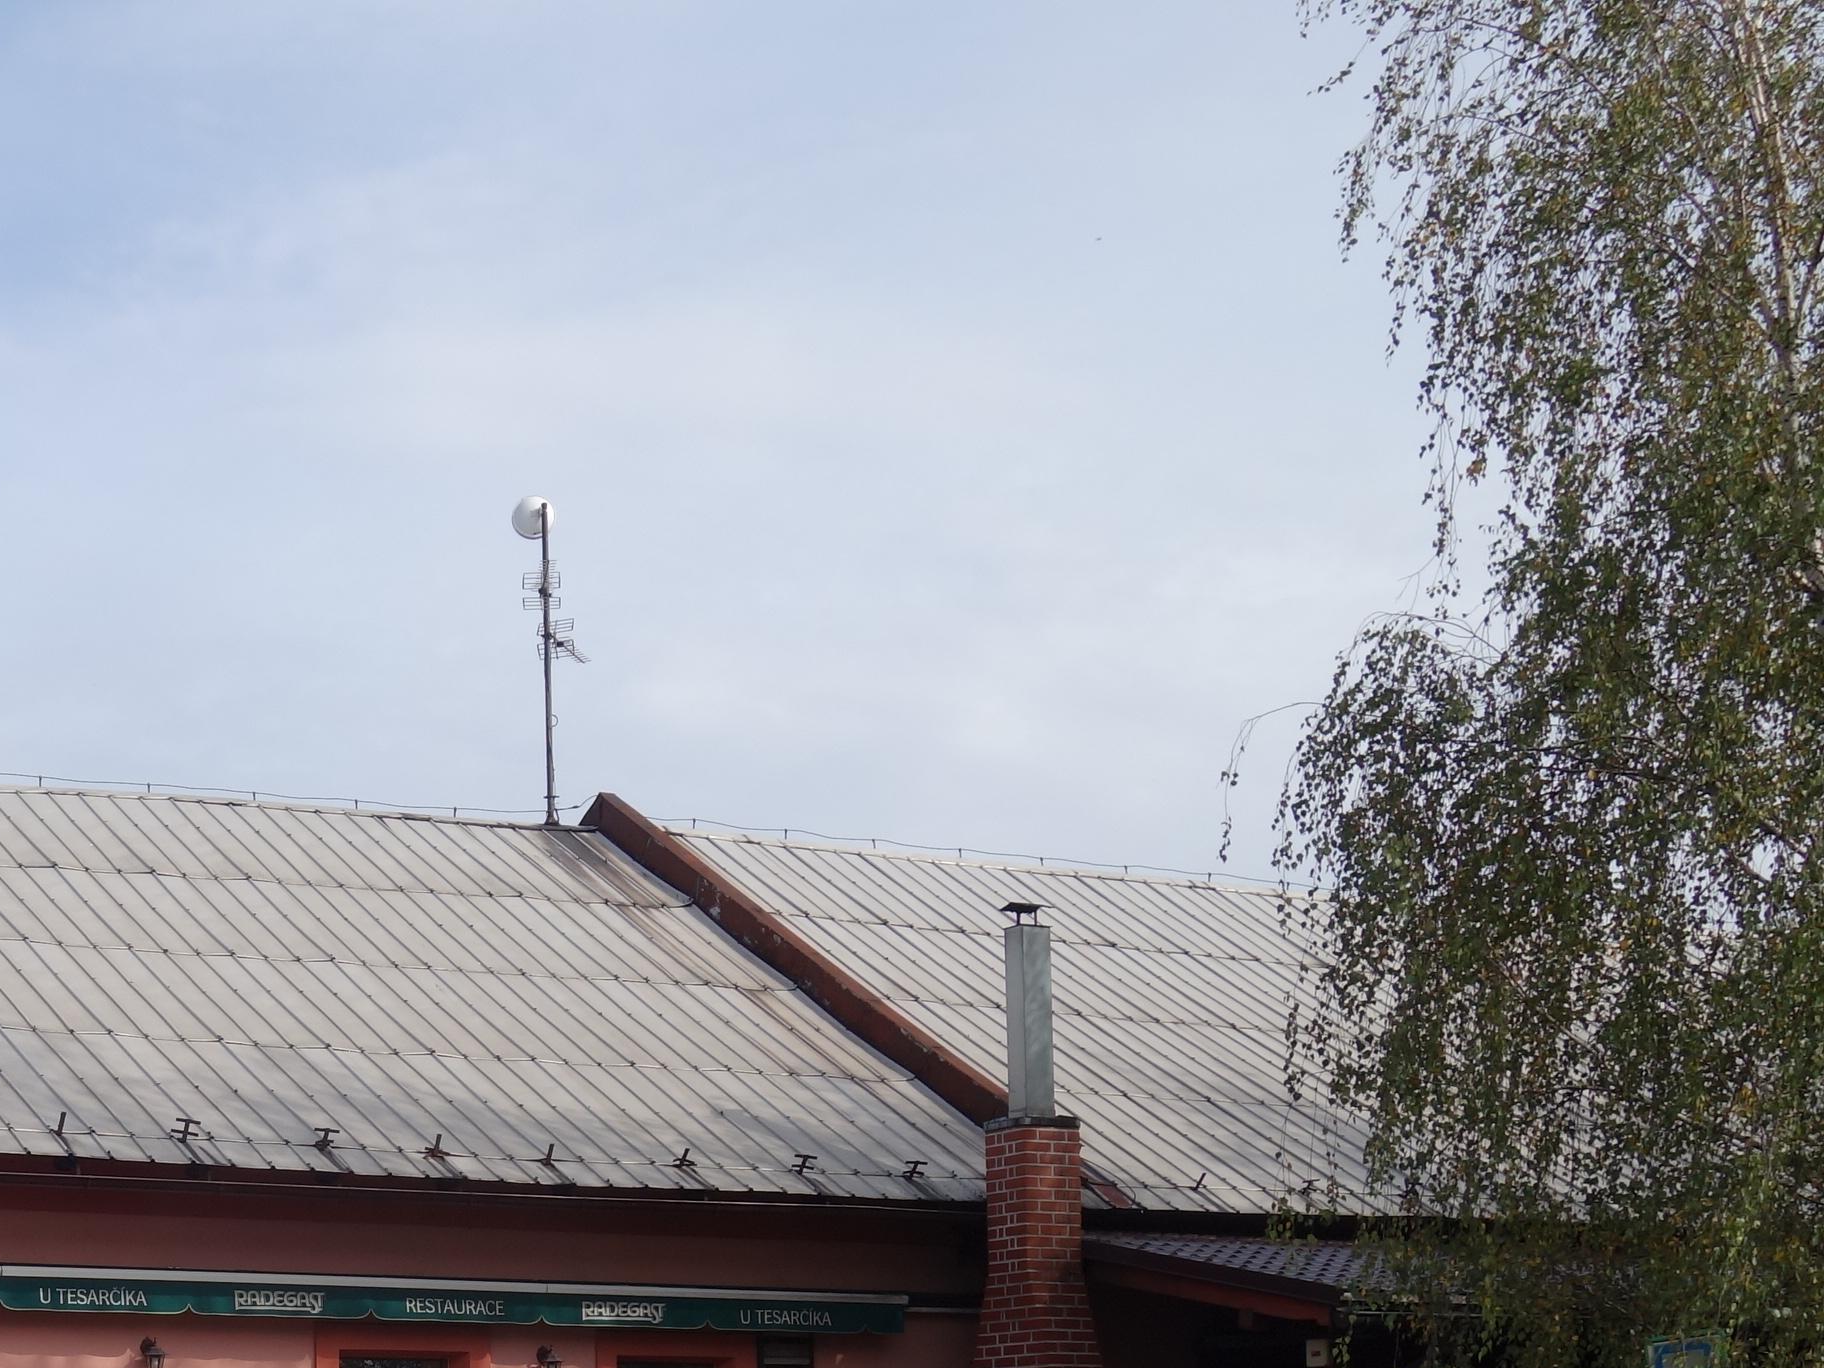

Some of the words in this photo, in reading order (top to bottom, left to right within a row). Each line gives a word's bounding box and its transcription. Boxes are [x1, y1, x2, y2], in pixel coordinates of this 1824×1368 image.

[39, 1287, 51, 1304] U
[56, 1286, 147, 1306] TESARČÍKA
[234, 1290, 324, 1314] RADEGAST
[406, 1298, 505, 1316] RESTAURACE
[582, 1301, 666, 1324] RADEGAST
[740, 1310, 751, 1325] U
